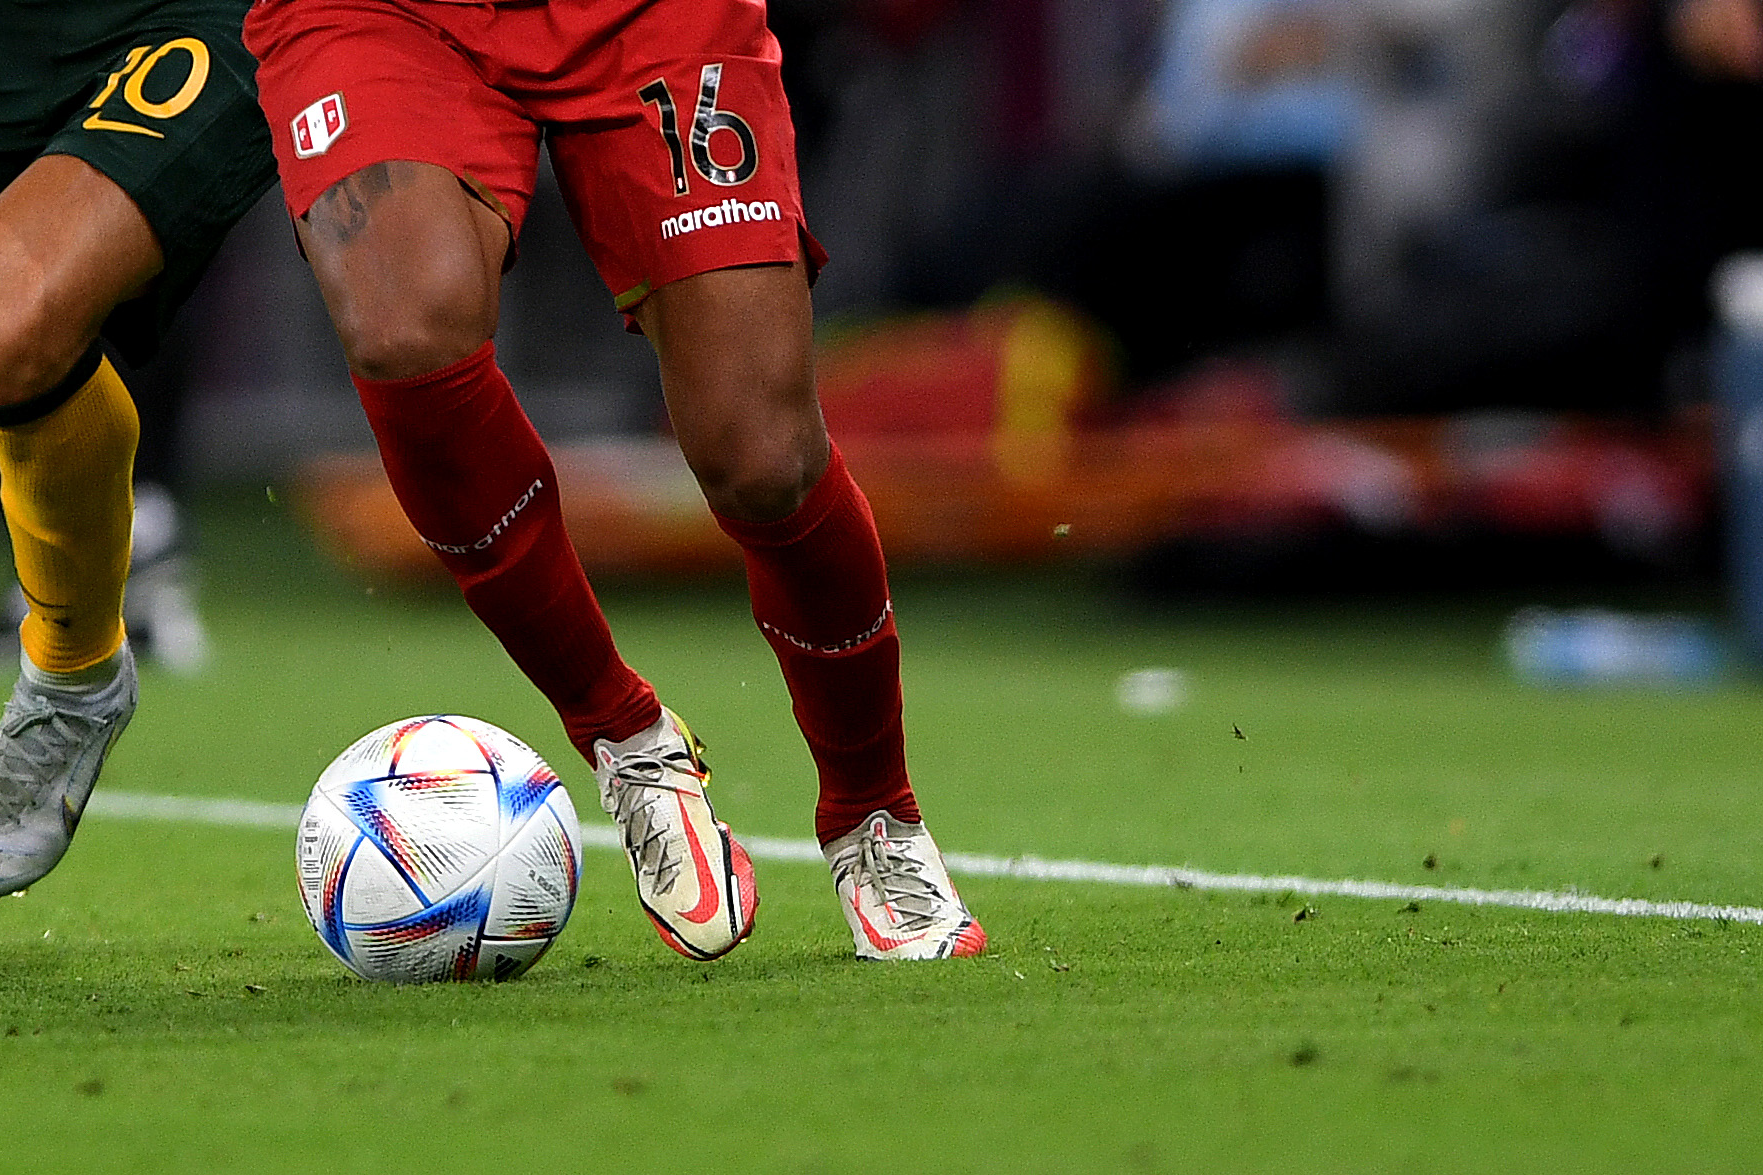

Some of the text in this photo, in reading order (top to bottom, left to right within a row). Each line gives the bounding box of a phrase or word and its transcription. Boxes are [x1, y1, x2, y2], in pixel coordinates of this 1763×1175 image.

[89, 37, 210, 119] 10
[636, 62, 759, 199] 16
[661, 198, 781, 240] marathon
